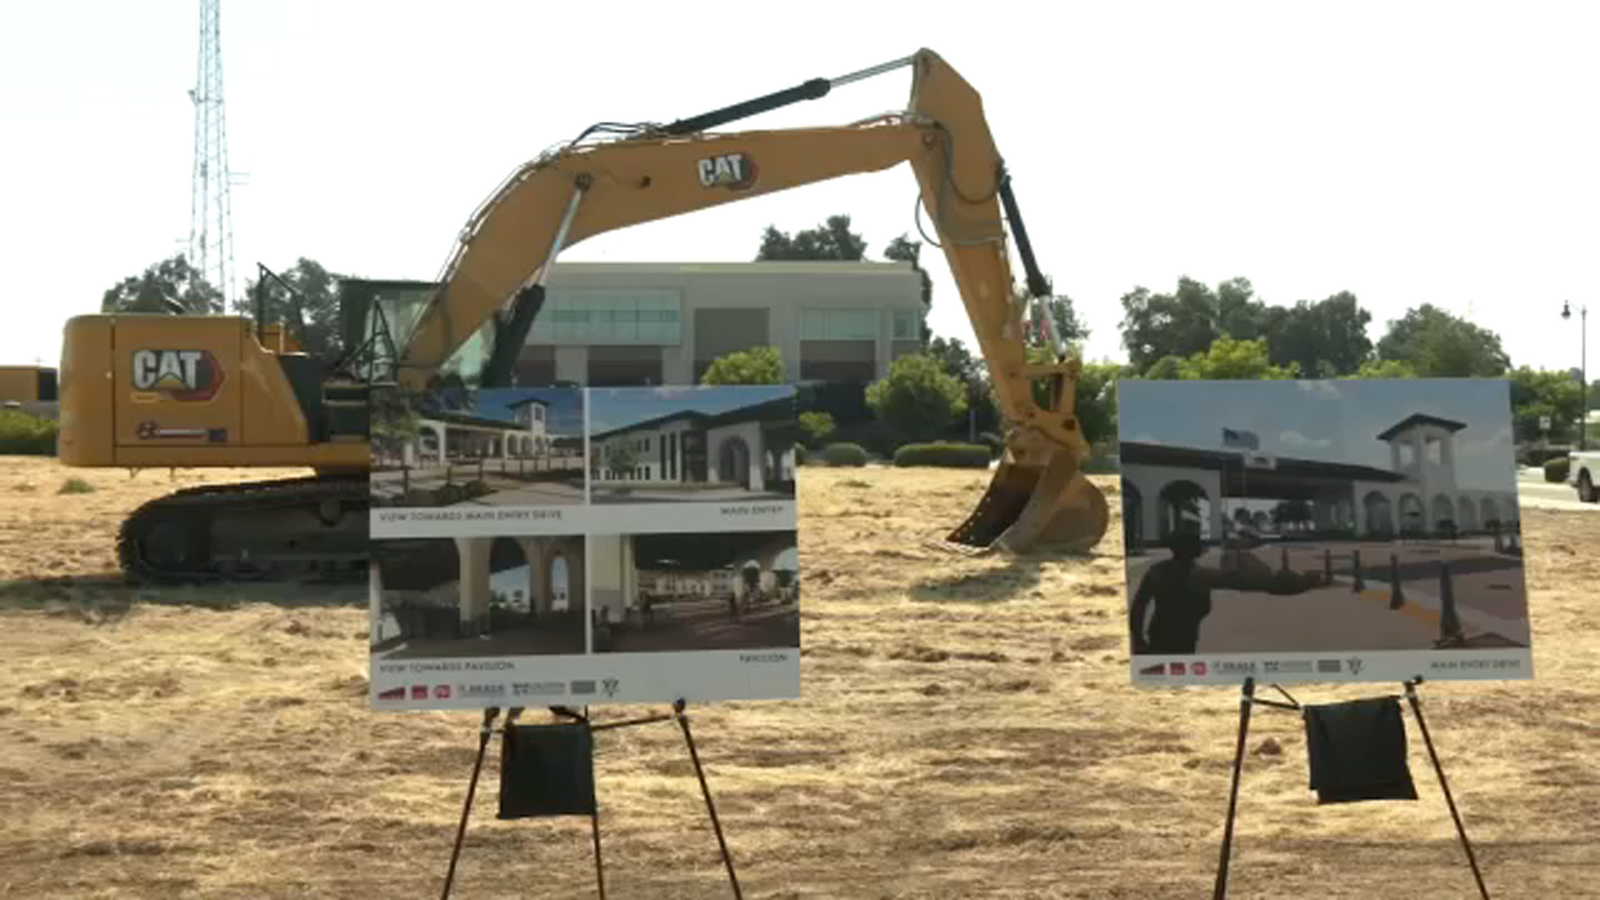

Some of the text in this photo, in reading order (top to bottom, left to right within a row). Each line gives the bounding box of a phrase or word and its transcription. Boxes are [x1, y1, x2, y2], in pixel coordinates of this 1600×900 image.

[699, 153, 741, 186] CAT
[134, 350, 201, 389] CAT
[380, 511, 407, 522] VIEW
[410, 511, 462, 521] TOWARDS
[465, 511, 495, 520] MAIN
[532, 509, 562, 520] DRIVE
[380, 661, 515, 673] VIEW TOWARDS PAVILION
